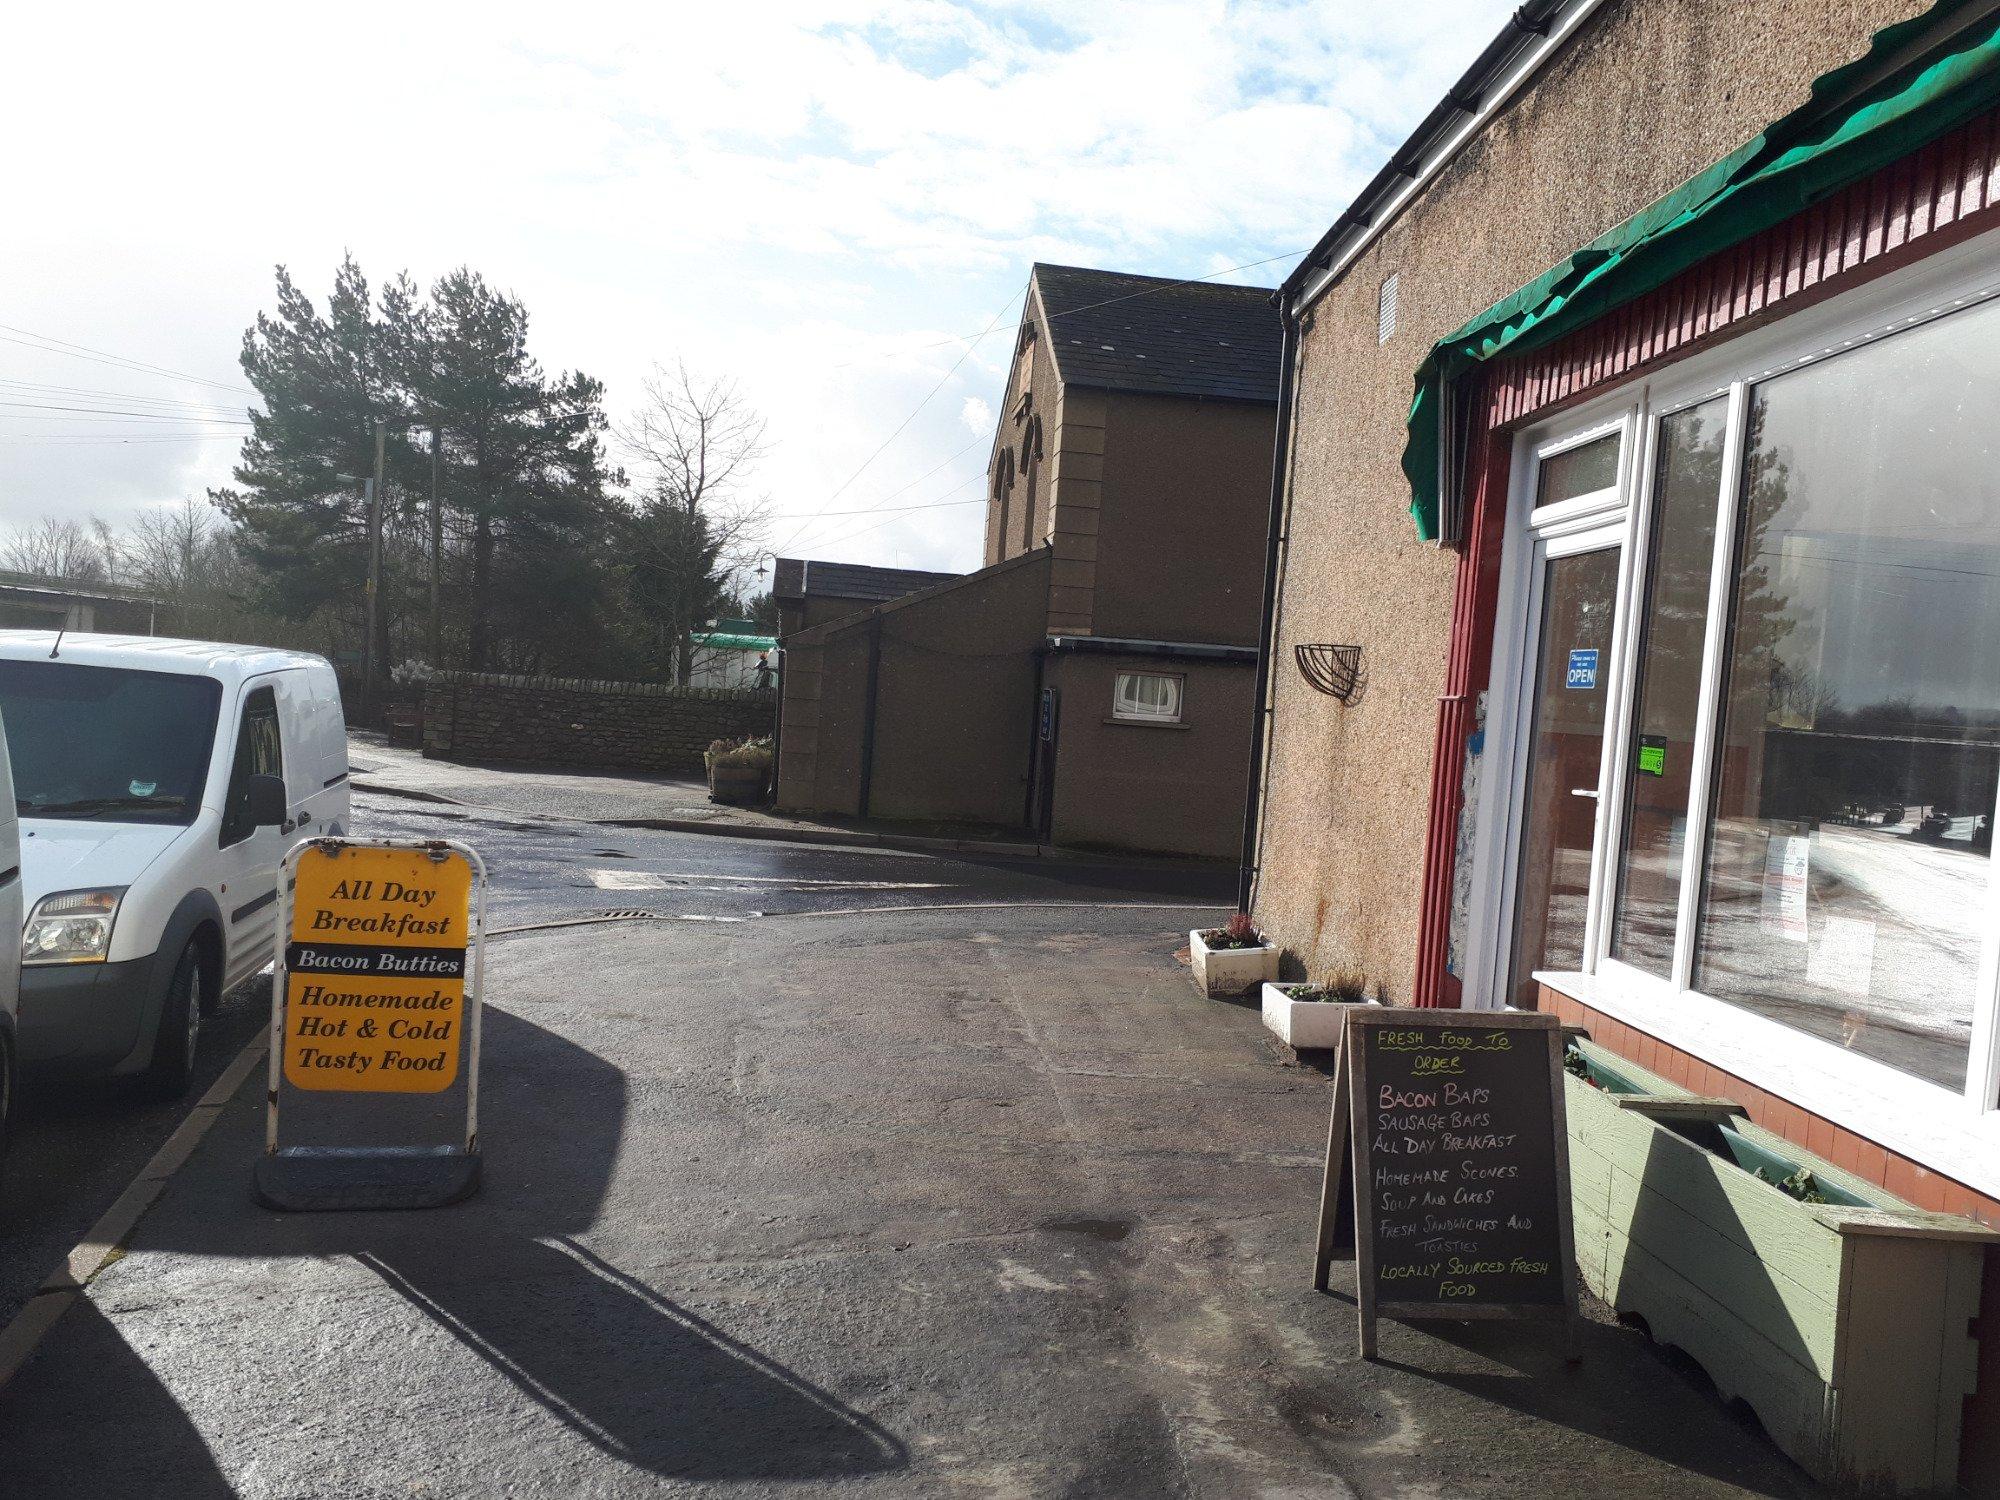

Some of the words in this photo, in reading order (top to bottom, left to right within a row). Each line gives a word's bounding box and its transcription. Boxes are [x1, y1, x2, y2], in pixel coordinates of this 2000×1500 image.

[1568, 669, 1595, 683] OPEN
[329, 879, 373, 901] All
[380, 882, 437, 909] Day
[311, 909, 451, 938] Breakfast
[297, 950, 370, 970] Bacon
[376, 953, 459, 973] Butties
[298, 986, 453, 1011] Homemade
[296, 1016, 349, 1037] Hot
[356, 1018, 380, 1039] &
[388, 1019, 452, 1040] Cold
[1378, 1030, 1423, 1045] FRESH
[1439, 1032, 1472, 1047] FOOD
[1485, 1032, 1510, 1046] TO
[299, 1048, 373, 1074] Tasty
[379, 1050, 447, 1071] Food
[1414, 1055, 1460, 1070] ORDER
[1379, 1084, 1437, 1109] BACON
[1443, 1083, 1490, 1106] BAPS
[1378, 1113, 1446, 1132] SAUSAGE
[1450, 1111, 1490, 1129] BAPS
[1373, 1133, 1398, 1154] ALL
[1403, 1137, 1436, 1154] DAY
[1441, 1133, 1517, 1151] BREAKFAST
[1375, 1166, 1449, 1189] HOMEMADE
[1381, 1192, 1416, 1211] SOUP
[1421, 1191, 1446, 1206] AND
[1454, 1187, 1495, 1205] CAKES
[1379, 1219, 1416, 1238] FRESH
[1423, 1215, 1499, 1233] SANDWICHES
[1507, 1214, 1532, 1230] AND
[1414, 1237, 1478, 1253] TOASTIES
[1380, 1263, 1441, 1280] LOCALLY
[1447, 1257, 1504, 1275] SOURCED
[1509, 1257, 1548, 1274] FRESH
[1439, 1281, 1476, 1298] FOOD
